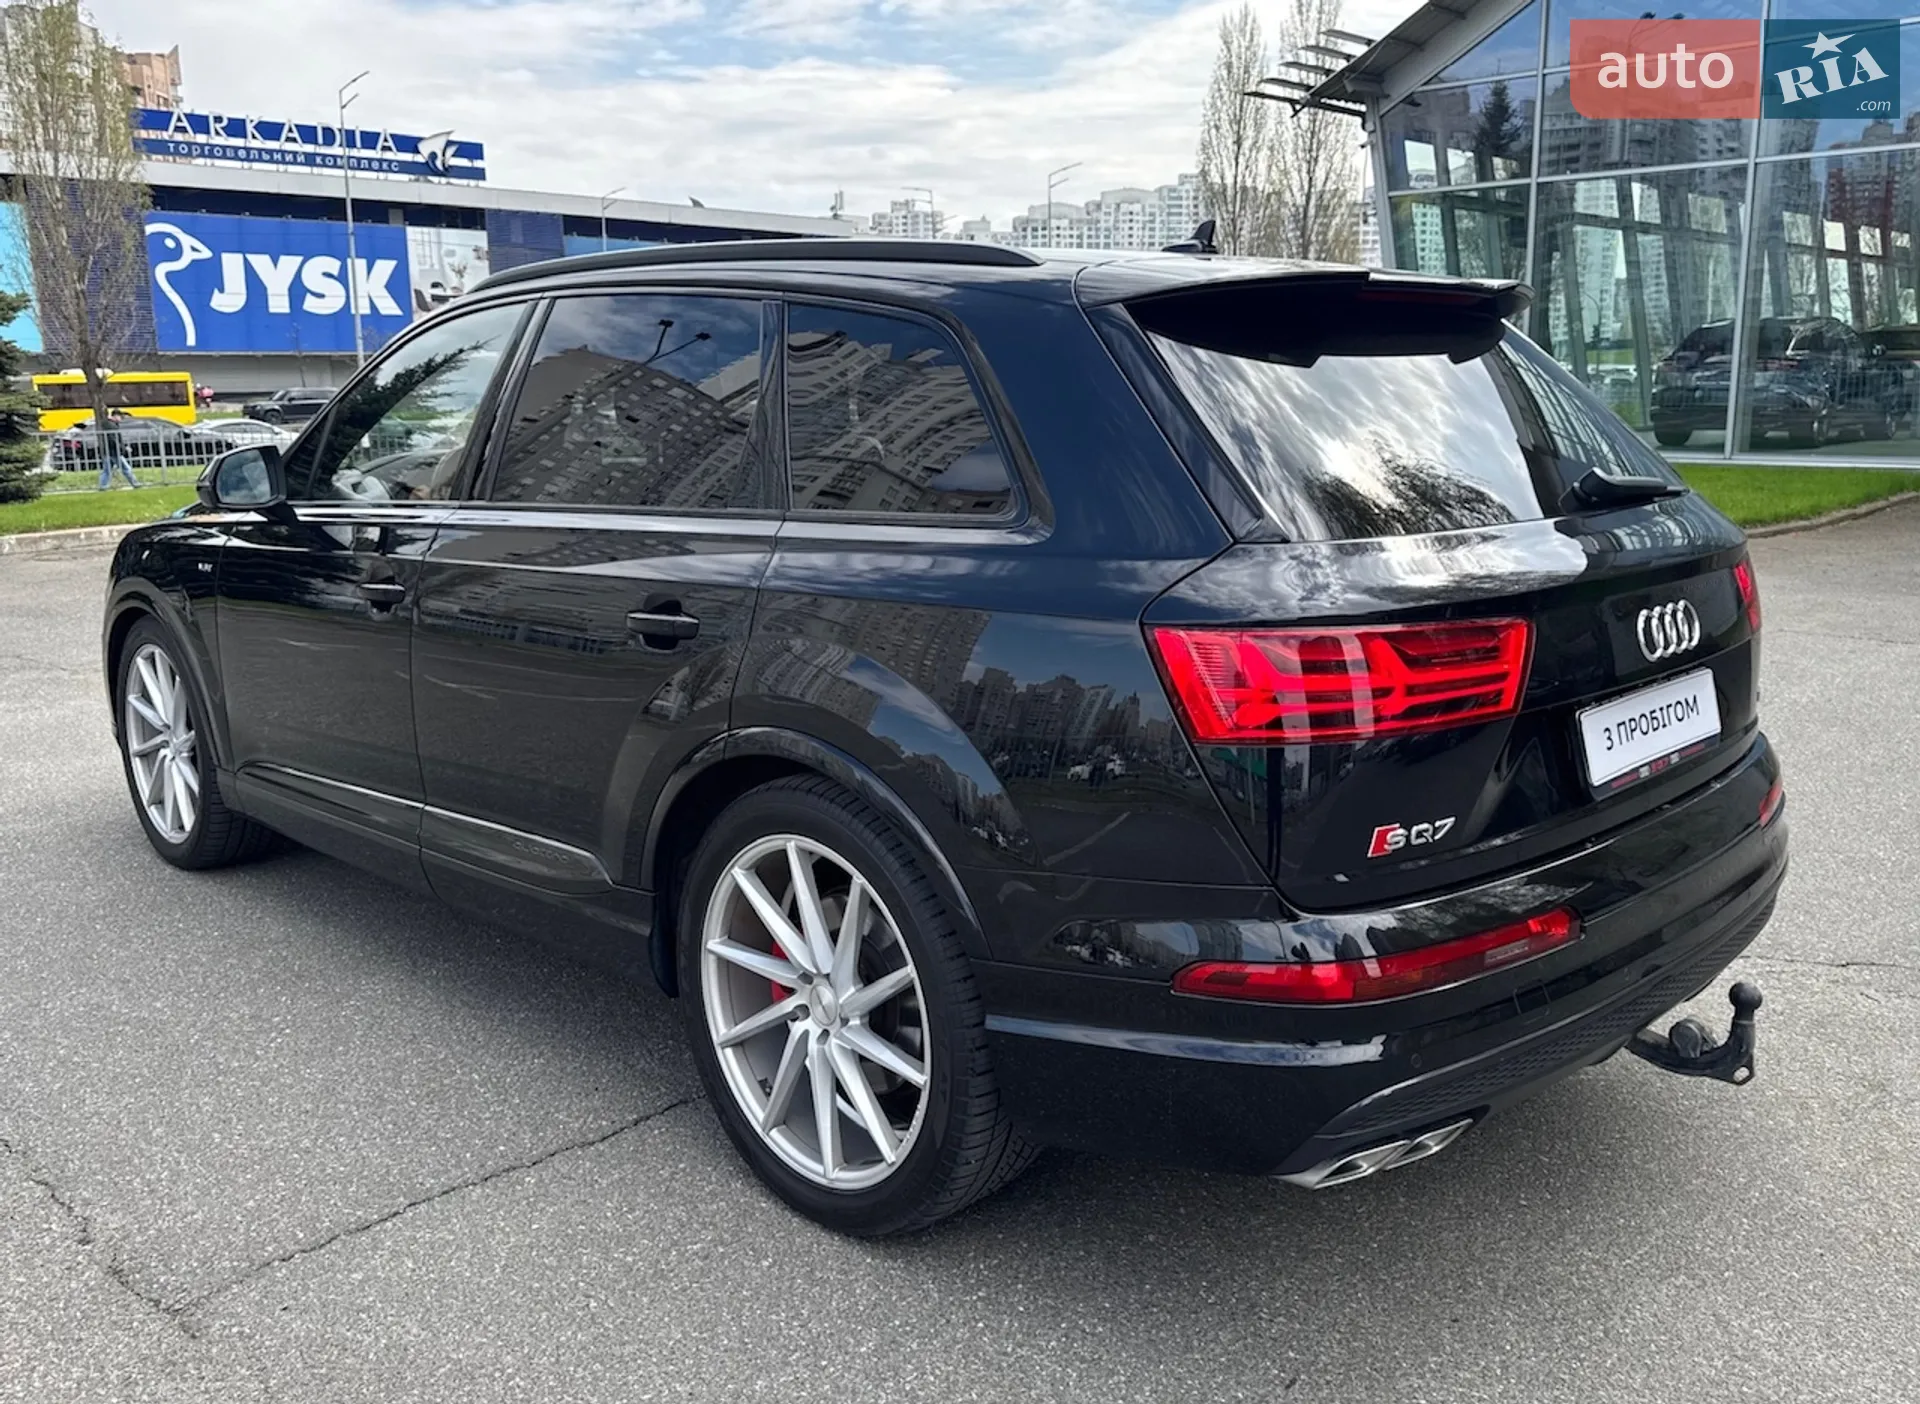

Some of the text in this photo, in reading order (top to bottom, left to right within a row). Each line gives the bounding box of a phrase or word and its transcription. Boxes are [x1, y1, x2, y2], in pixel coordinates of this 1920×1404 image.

[167, 108, 400, 154] ARKADIA
[167, 142, 400, 172] торговельний комплекс
[209, 252, 405, 316] JYSK
[1603, 694, 1700, 751] З ПРОБІГОМ
[1382, 816, 1456, 852] SQ7
